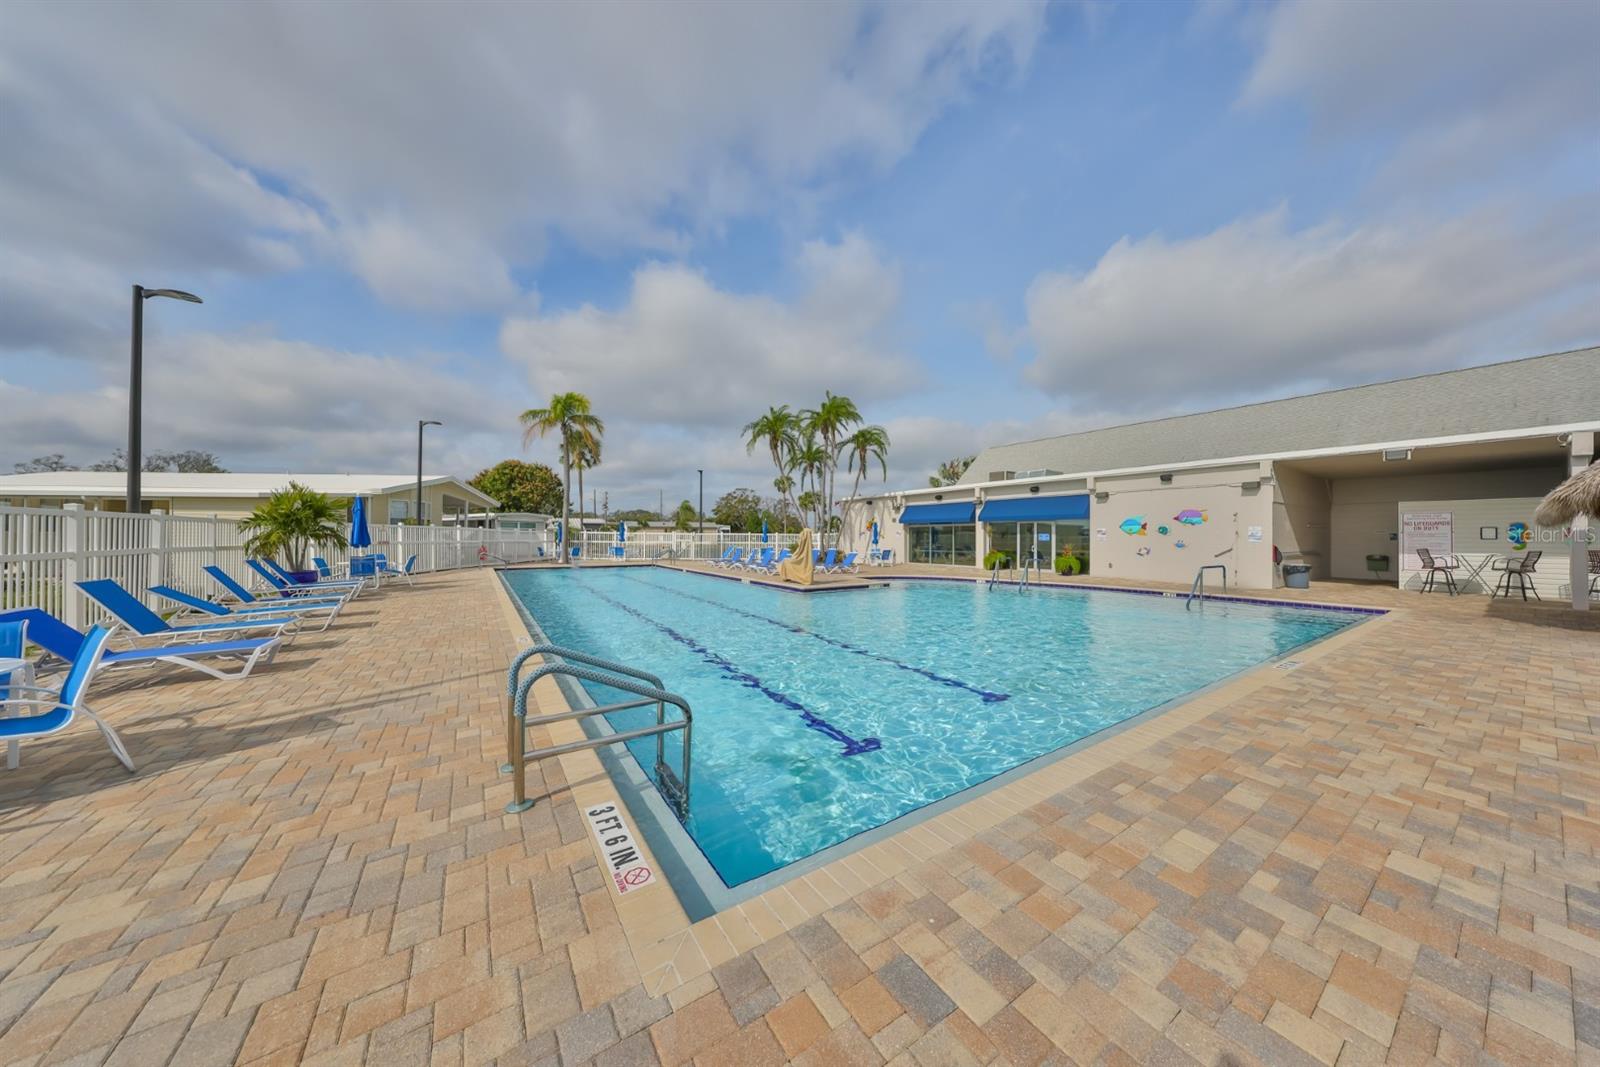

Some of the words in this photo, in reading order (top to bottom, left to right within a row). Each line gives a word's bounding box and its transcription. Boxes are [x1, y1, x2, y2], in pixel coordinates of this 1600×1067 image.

[589, 806, 615, 817] 3
[596, 815, 622, 835] FT.
[605, 835, 628, 846] 6
[610, 846, 639, 870] IN.
